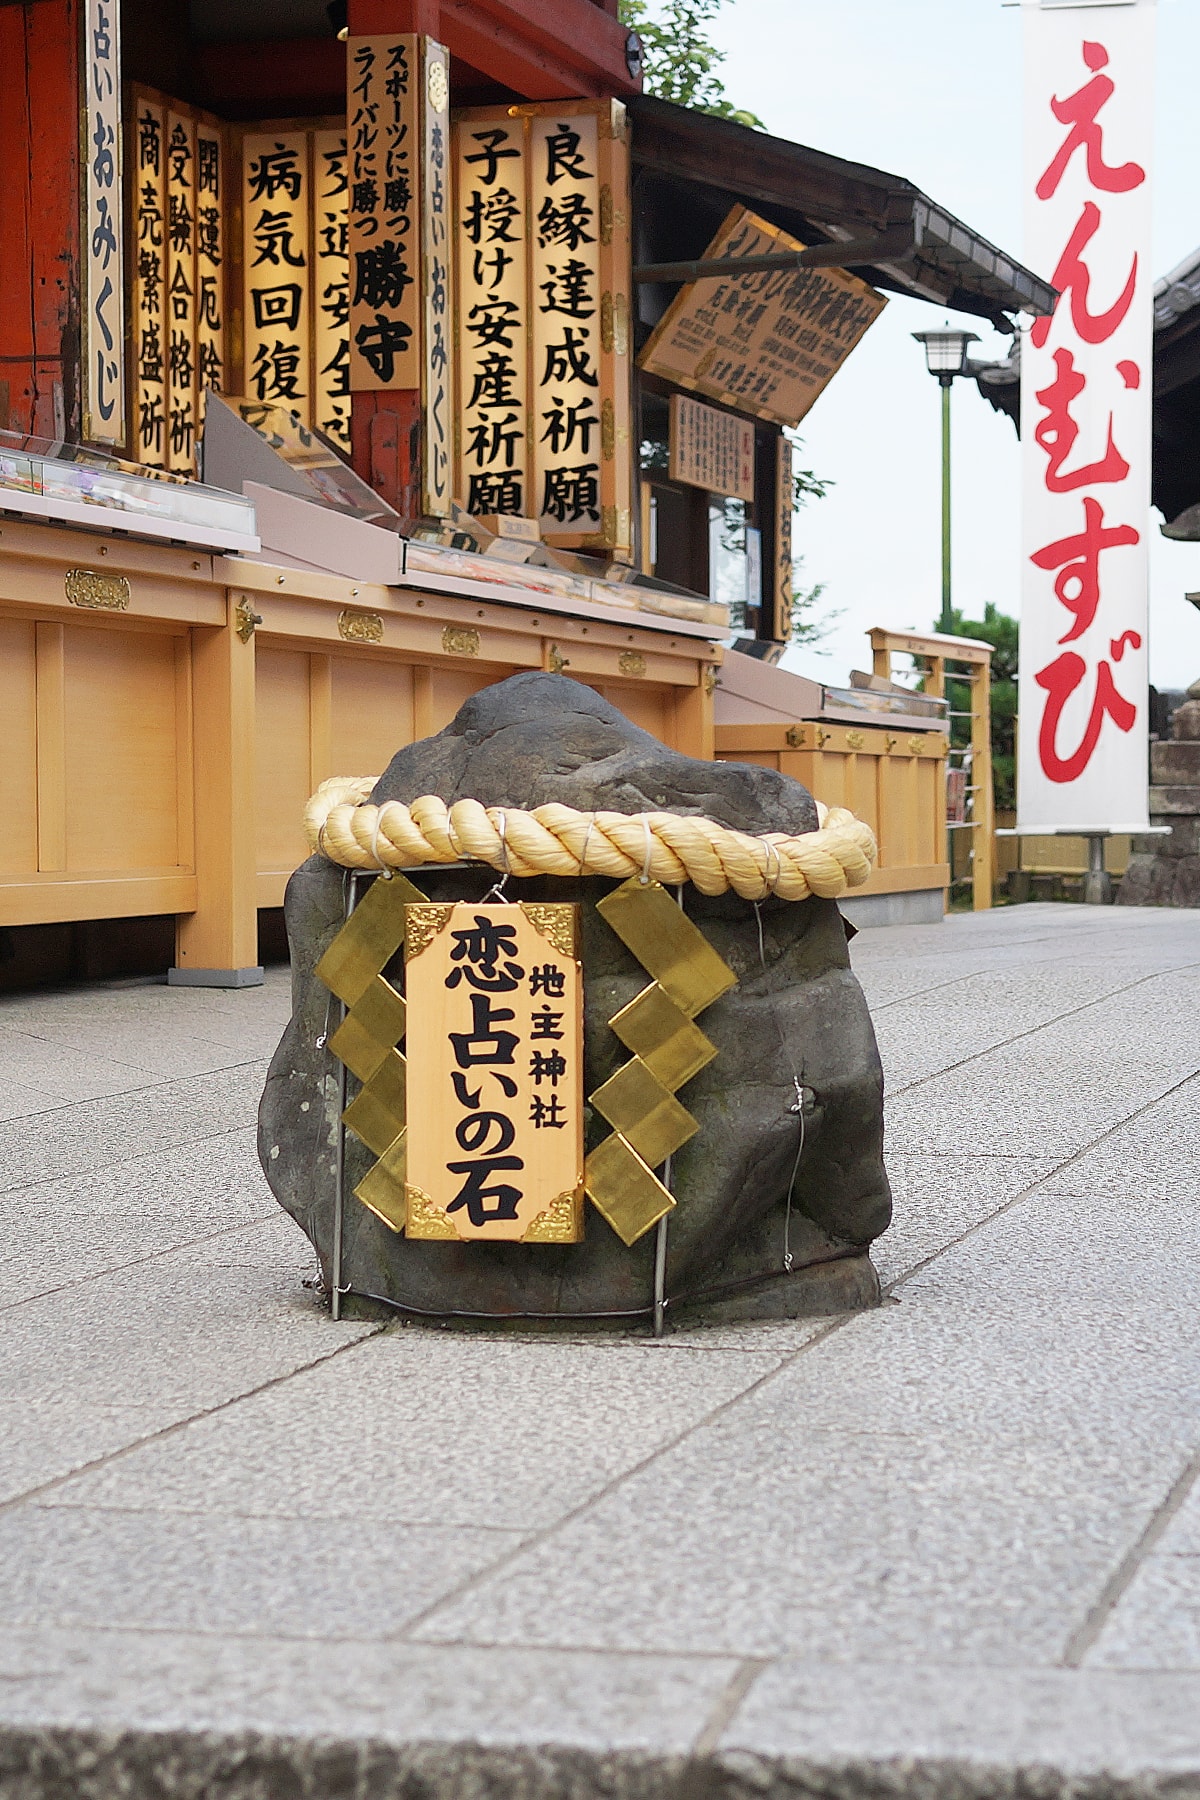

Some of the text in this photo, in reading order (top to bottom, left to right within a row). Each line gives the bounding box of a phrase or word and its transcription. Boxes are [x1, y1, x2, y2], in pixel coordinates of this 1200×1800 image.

[92, 0, 118, 420] 占いおみくじ
[197, 138, 222, 440] 開運厄除
[247, 142, 306, 424] 病気回復
[350, 46, 380, 238] ライバルに勝つ
[384, 46, 412, 237] スポーツに勝つ
[353, 241, 414, 383] 勝守
[462, 129, 523, 518] 子授け安産祈願
[536, 124, 600, 524] 良縁達成祈願
[1030, 40, 1147, 783] えんむすび
[445, 915, 524, 1228] 恋占いの石
[529, 964, 568, 1130] 地主神社
